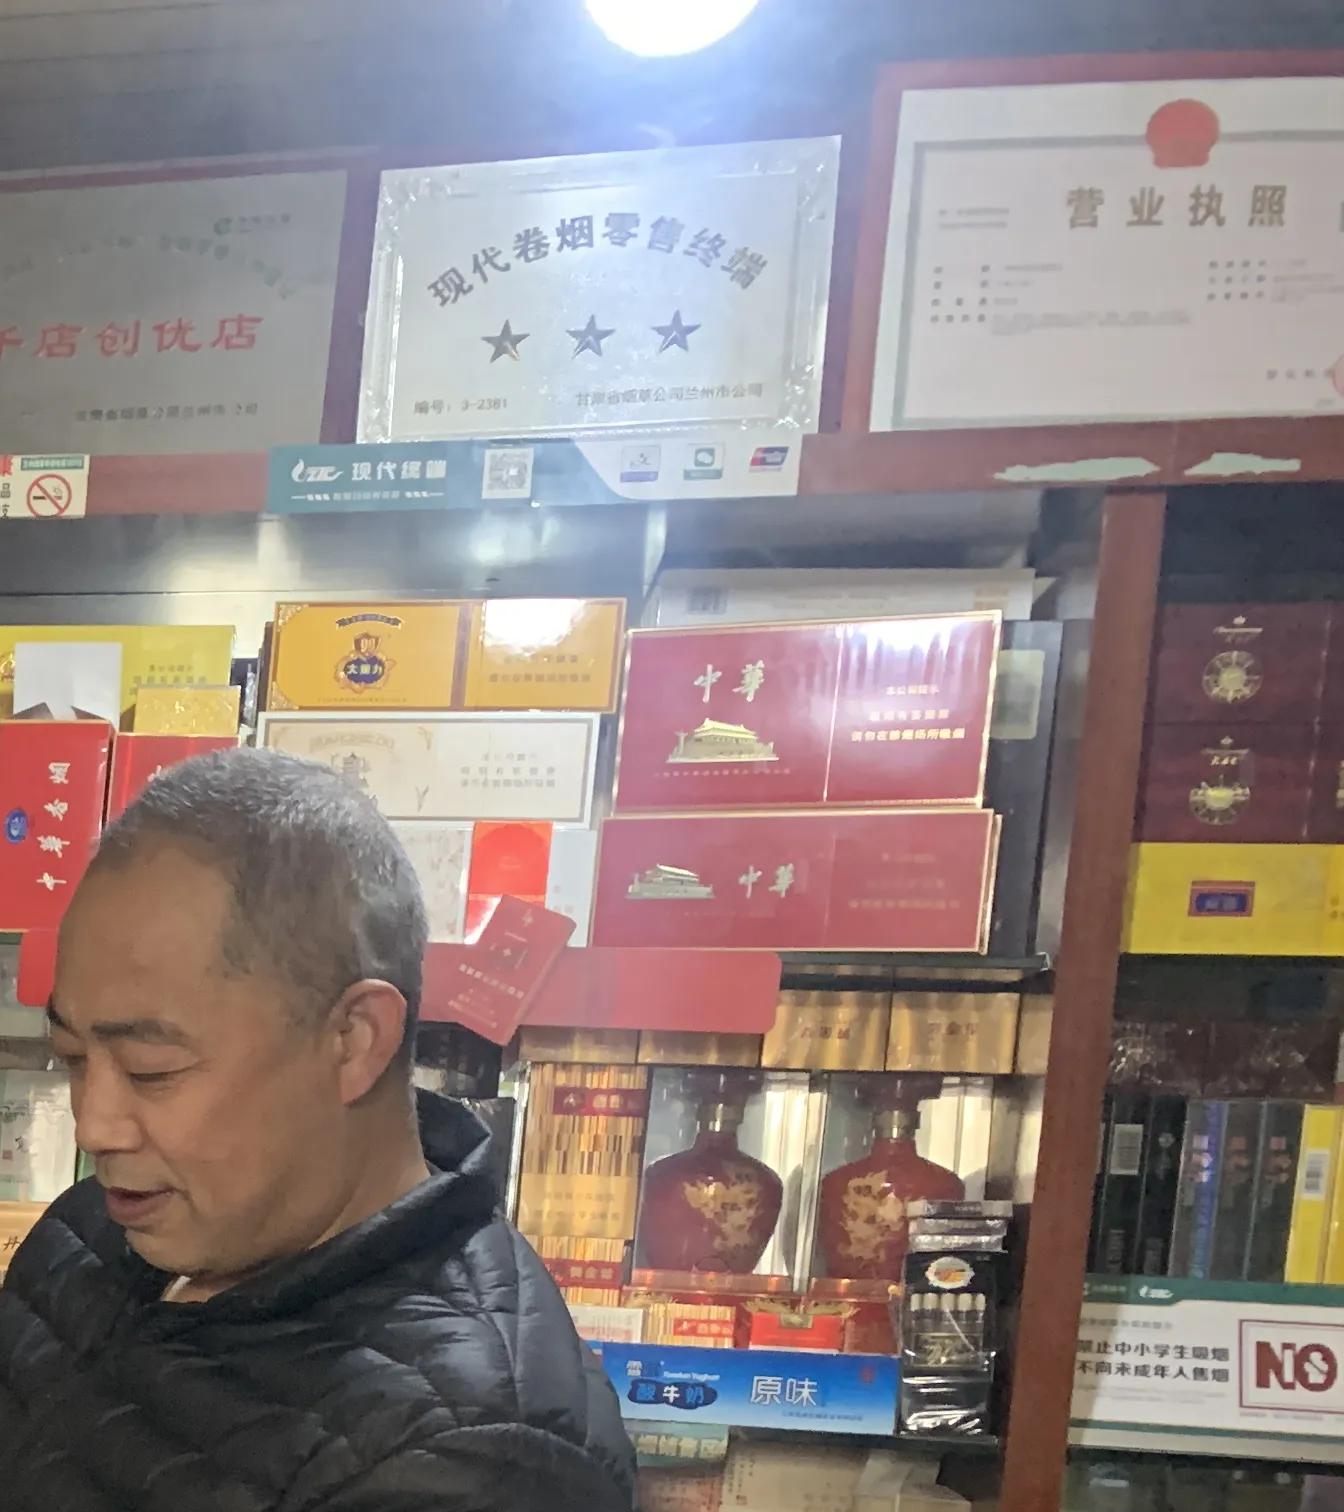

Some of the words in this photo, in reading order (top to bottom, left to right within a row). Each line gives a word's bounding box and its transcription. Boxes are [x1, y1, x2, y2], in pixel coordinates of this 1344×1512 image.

[1065, 183, 1288, 229] 营业执照
[426, 211, 769, 308] 现代卷烟零售终端
[693, 659, 766, 703] 中華
[1255, 1340, 1337, 1393] NO
[751, 1375, 818, 1406] 原味
